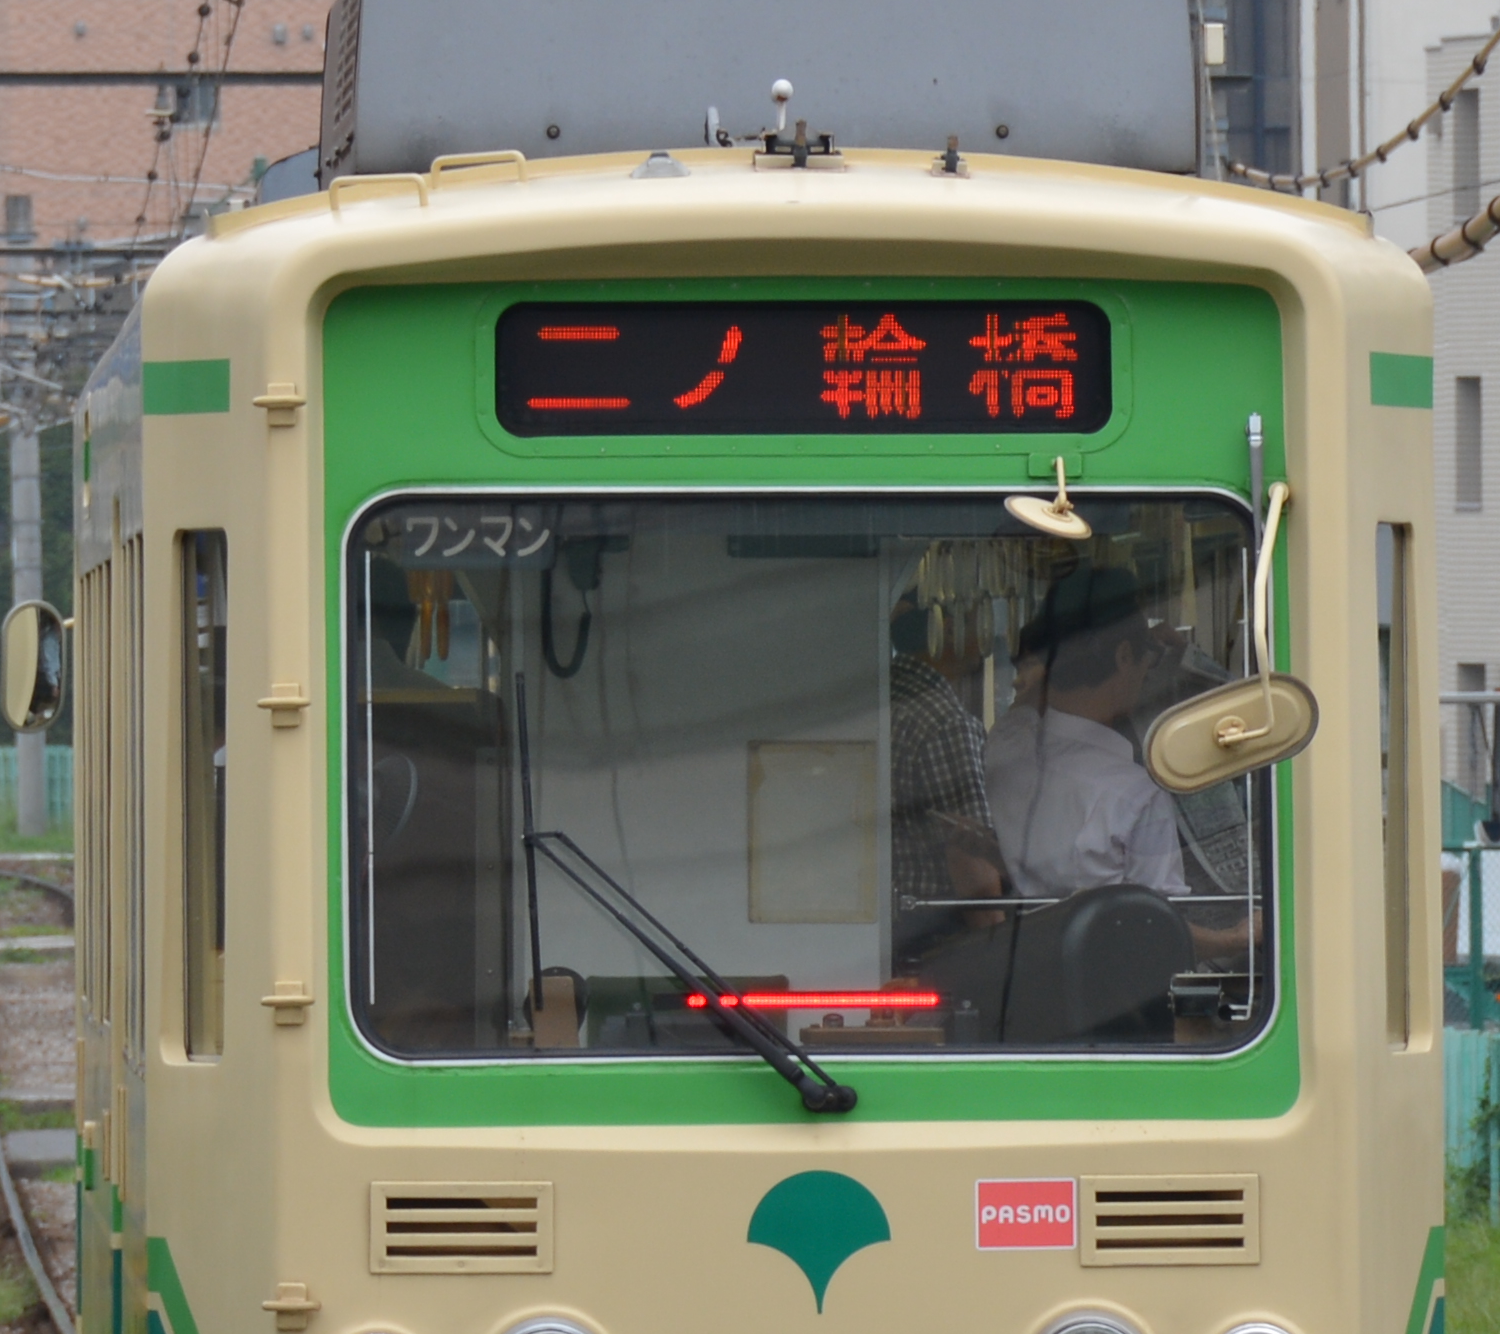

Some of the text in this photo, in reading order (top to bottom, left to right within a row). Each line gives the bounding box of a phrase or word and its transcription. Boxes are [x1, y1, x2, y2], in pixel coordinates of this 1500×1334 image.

[527, 313, 1078, 419] 二ノ輪橋
[406, 516, 550, 557] ワンマン
[981, 1204, 1071, 1225] PASMO
